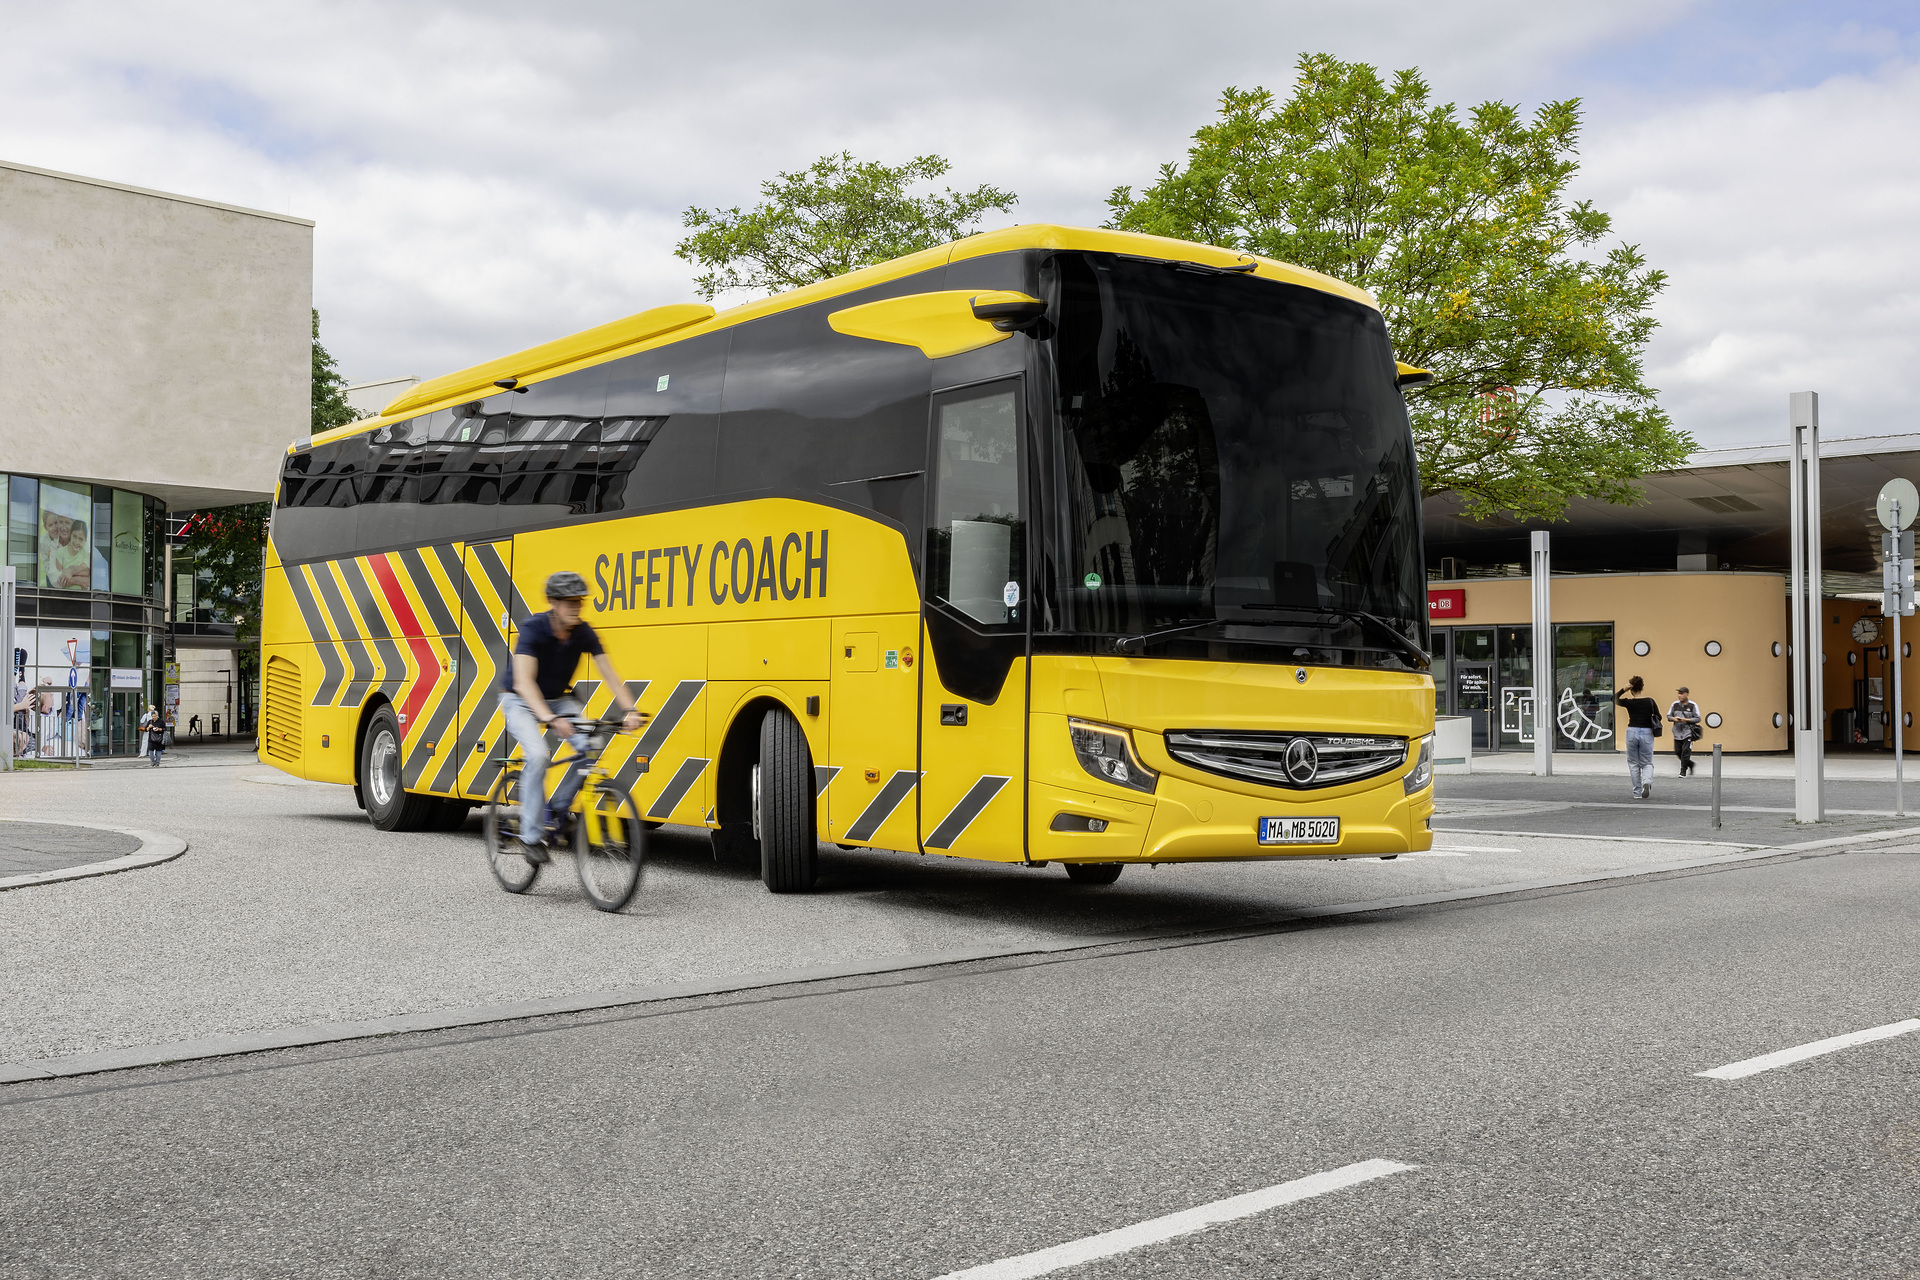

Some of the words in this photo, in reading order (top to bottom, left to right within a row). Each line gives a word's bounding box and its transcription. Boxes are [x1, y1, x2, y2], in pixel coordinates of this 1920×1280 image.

[593, 543, 704, 613] SAFETY
[709, 529, 829, 606] COACH
[1090, 573, 1096, 582] 4
[1506, 691, 1515, 706] 2
[1523, 701, 1532, 716] 1
[1327, 737, 1375, 746] TOURISMO
[1268, 821, 1283, 839] MA
[1291, 821, 1306, 838] MB
[1308, 820, 1336, 838] 5020
